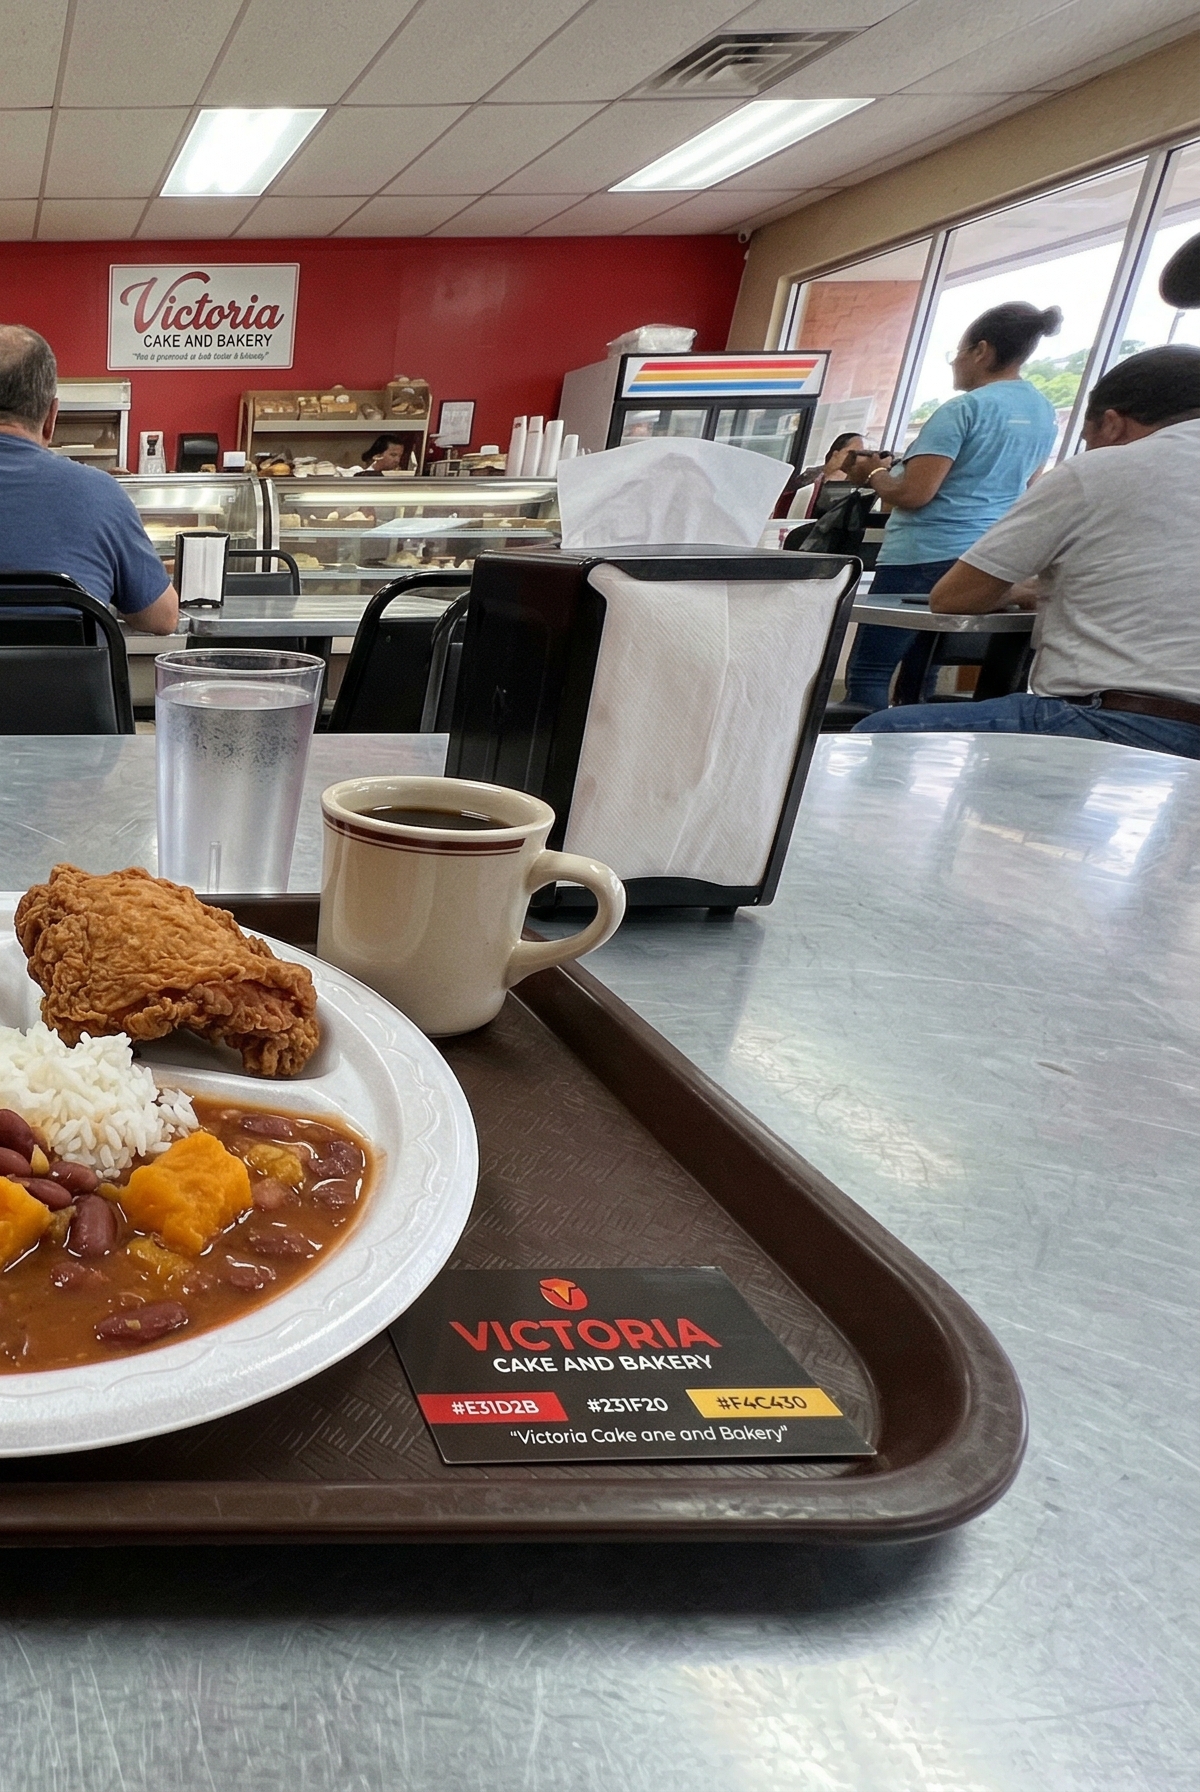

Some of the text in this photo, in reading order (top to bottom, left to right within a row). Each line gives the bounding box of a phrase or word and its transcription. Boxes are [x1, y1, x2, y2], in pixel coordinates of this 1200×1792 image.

[120, 271, 284, 333] Victoria
[143, 334, 273, 348] CAKE AND BAKERY
[449, 1318, 722, 1351] VICTORIA
[493, 1354, 712, 1373] CAKE AND BAKERY
[452, 1396, 808, 1415] #E31D2B #231F20 #F4C430
[510, 1425, 788, 1446] "Victoria Cake ane and Bakery"
